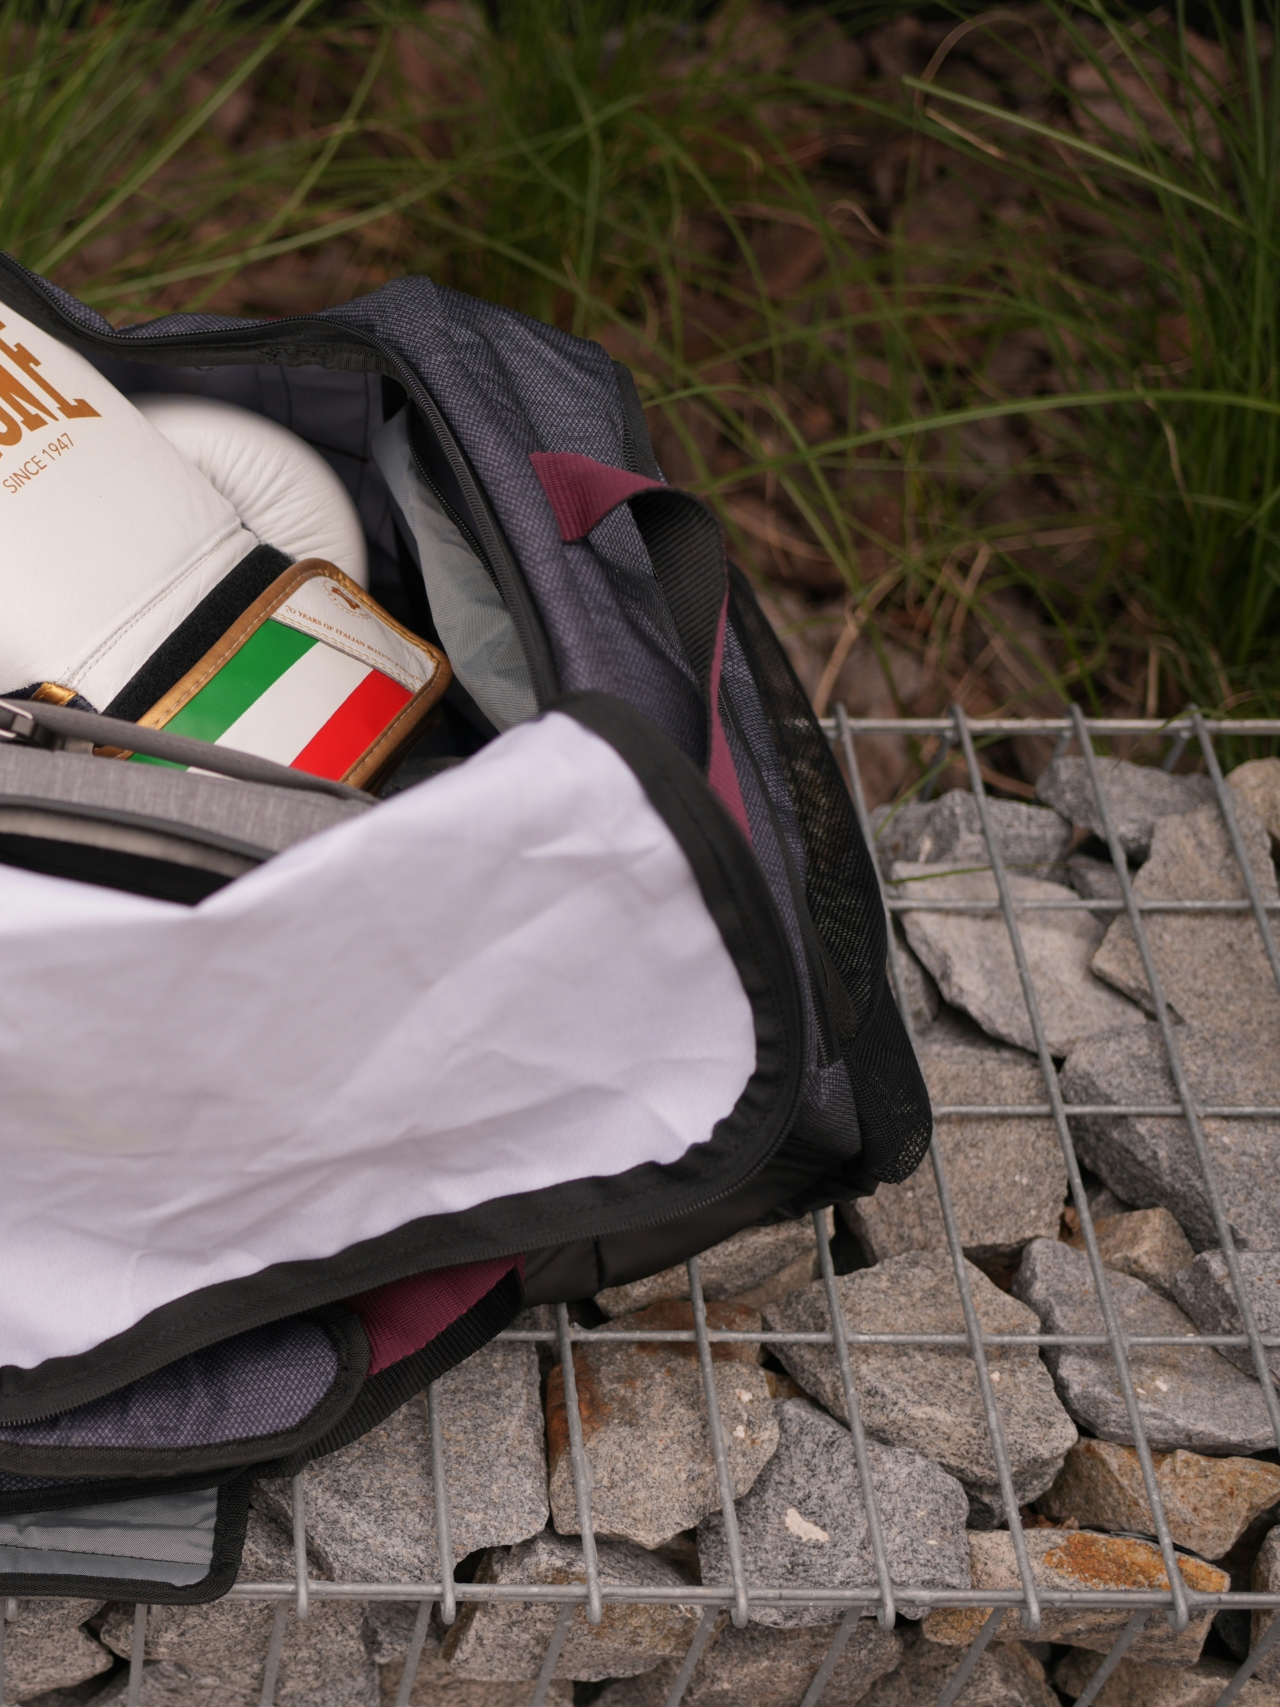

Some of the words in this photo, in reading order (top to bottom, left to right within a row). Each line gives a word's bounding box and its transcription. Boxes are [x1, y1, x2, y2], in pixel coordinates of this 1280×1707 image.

[2, 454, 48, 494] SINCE
[42, 432, 75, 461] 1947
[285, 604, 296, 614] 70
[298, 610, 322, 626] YEARS
[323, 622, 334, 631] OF
[335, 628, 365, 647] ITALIAN
